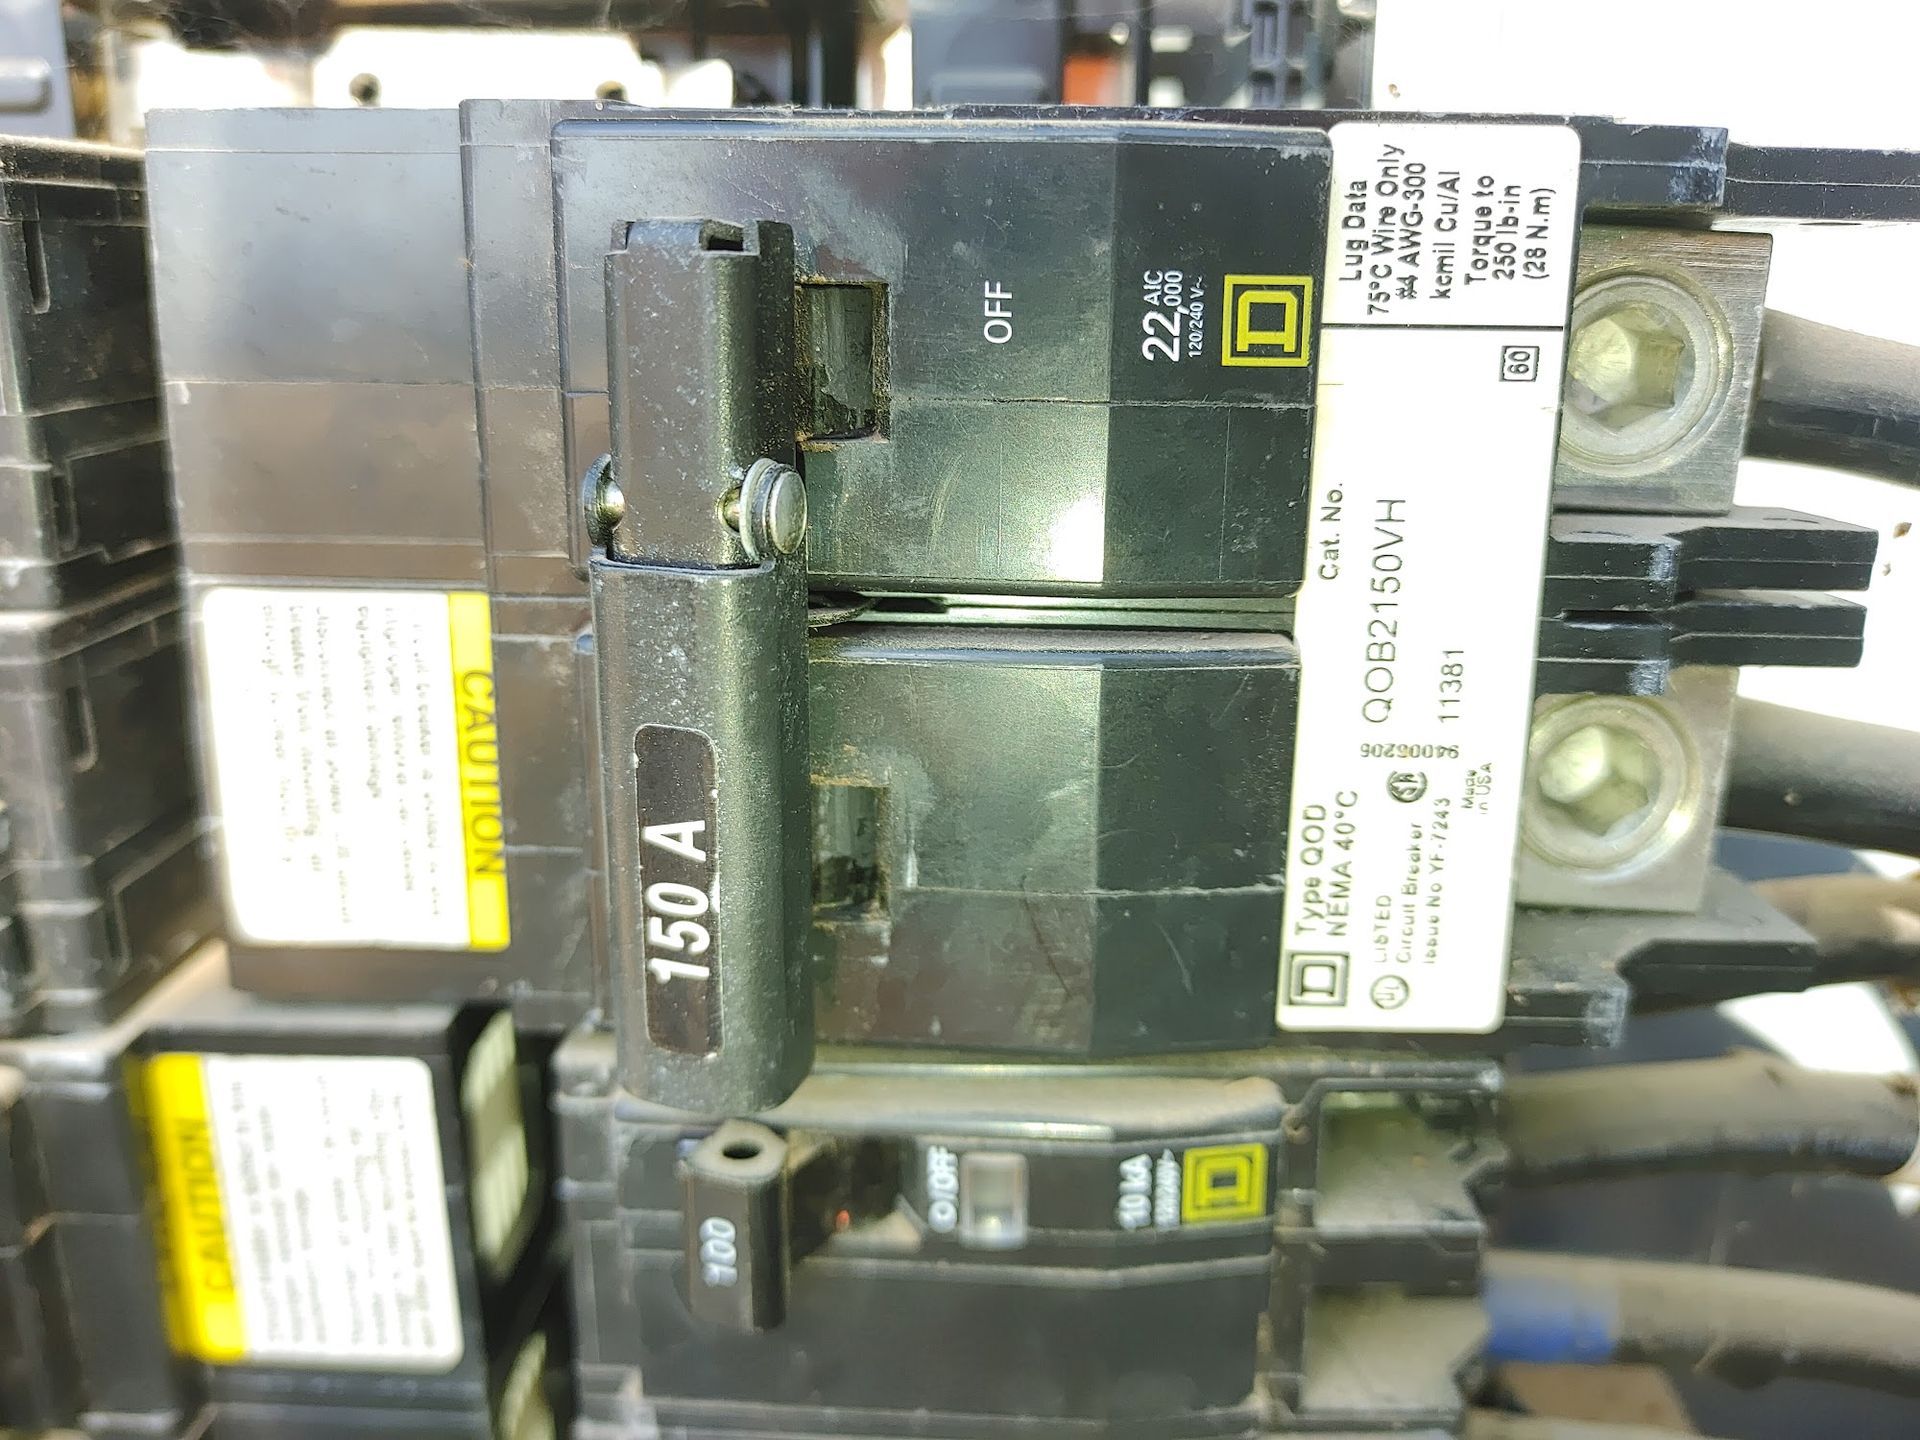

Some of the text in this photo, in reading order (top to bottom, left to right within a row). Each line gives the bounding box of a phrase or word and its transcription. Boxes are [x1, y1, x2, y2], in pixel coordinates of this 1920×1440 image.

[1338, 180, 1368, 281] Lug Data
[1366, 143, 1405, 315] 75°C Wire Only
[1394, 162, 1426, 300] #4 AWG-300
[1430, 170, 1460, 298] kcmil Cu/Al
[1464, 174, 1496, 285] Torque to
[1492, 184, 1521, 280] 250 lb-in
[1522, 188, 1556, 279] (28 N.m)
[984, 280, 1013, 344] OFF
[1143, 269, 1164, 305] AIC
[1188, 301, 1204, 357] 120/240
[1506, 350, 1530, 374] 60
[1317, 482, 1343, 580] Cat. No.
[1362, 498, 1406, 723] QOB2150VH
[1436, 648, 1464, 723] 11381
[462, 669, 506, 874] CAUTION
[1478, 762, 1492, 796] USA
[641, 820, 710, 984] 150 A
[1294, 804, 1326, 936] Type QOD
[1326, 790, 1358, 936] NEMA 40°C
[1397, 822, 1423, 964] Circuit Breaker
[1424, 882, 1442, 907] No
[1373, 894, 1392, 964] LISTED
[1422, 914, 1441, 964] Issue
[173, 1116, 234, 1292] CAUTION
[700, 1216, 738, 1286] 100
